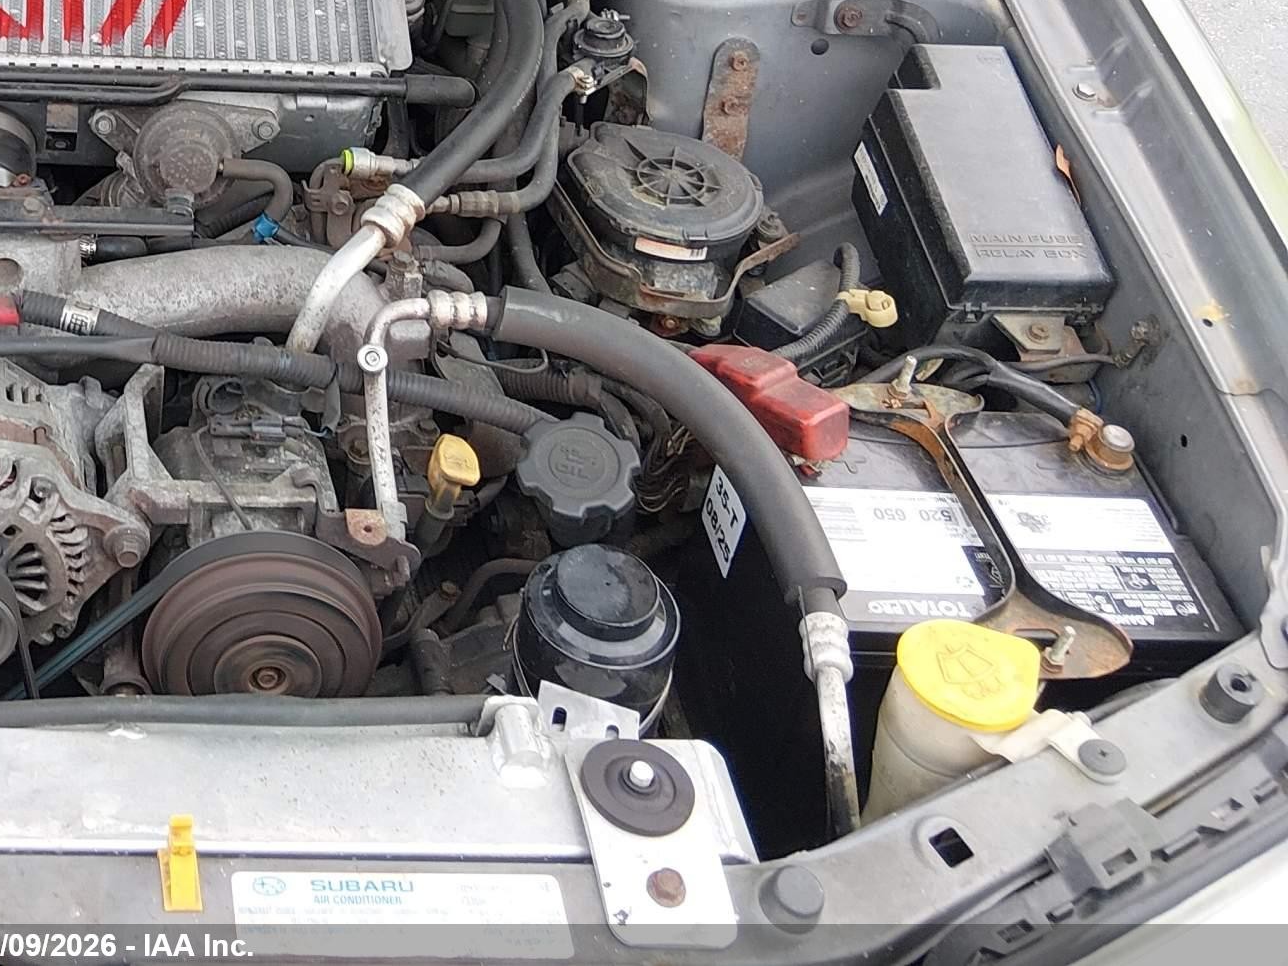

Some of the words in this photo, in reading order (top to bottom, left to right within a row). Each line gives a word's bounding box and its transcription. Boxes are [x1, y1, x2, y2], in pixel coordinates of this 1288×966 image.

[968, 233, 1022, 243] MAIN
[1027, 234, 1081, 245] FUSE
[975, 248, 1035, 259] RELAY
[1043, 249, 1088, 259] BOX
[715, 476, 739, 528] 35-T
[873, 507, 906, 522] 650
[918, 507, 952, 523] 520
[705, 497, 731, 563] 08/25
[309, 879, 415, 893] SUBARU
[313, 894, 330, 904] AIR
[333, 895, 403, 906] CONDITIONER
